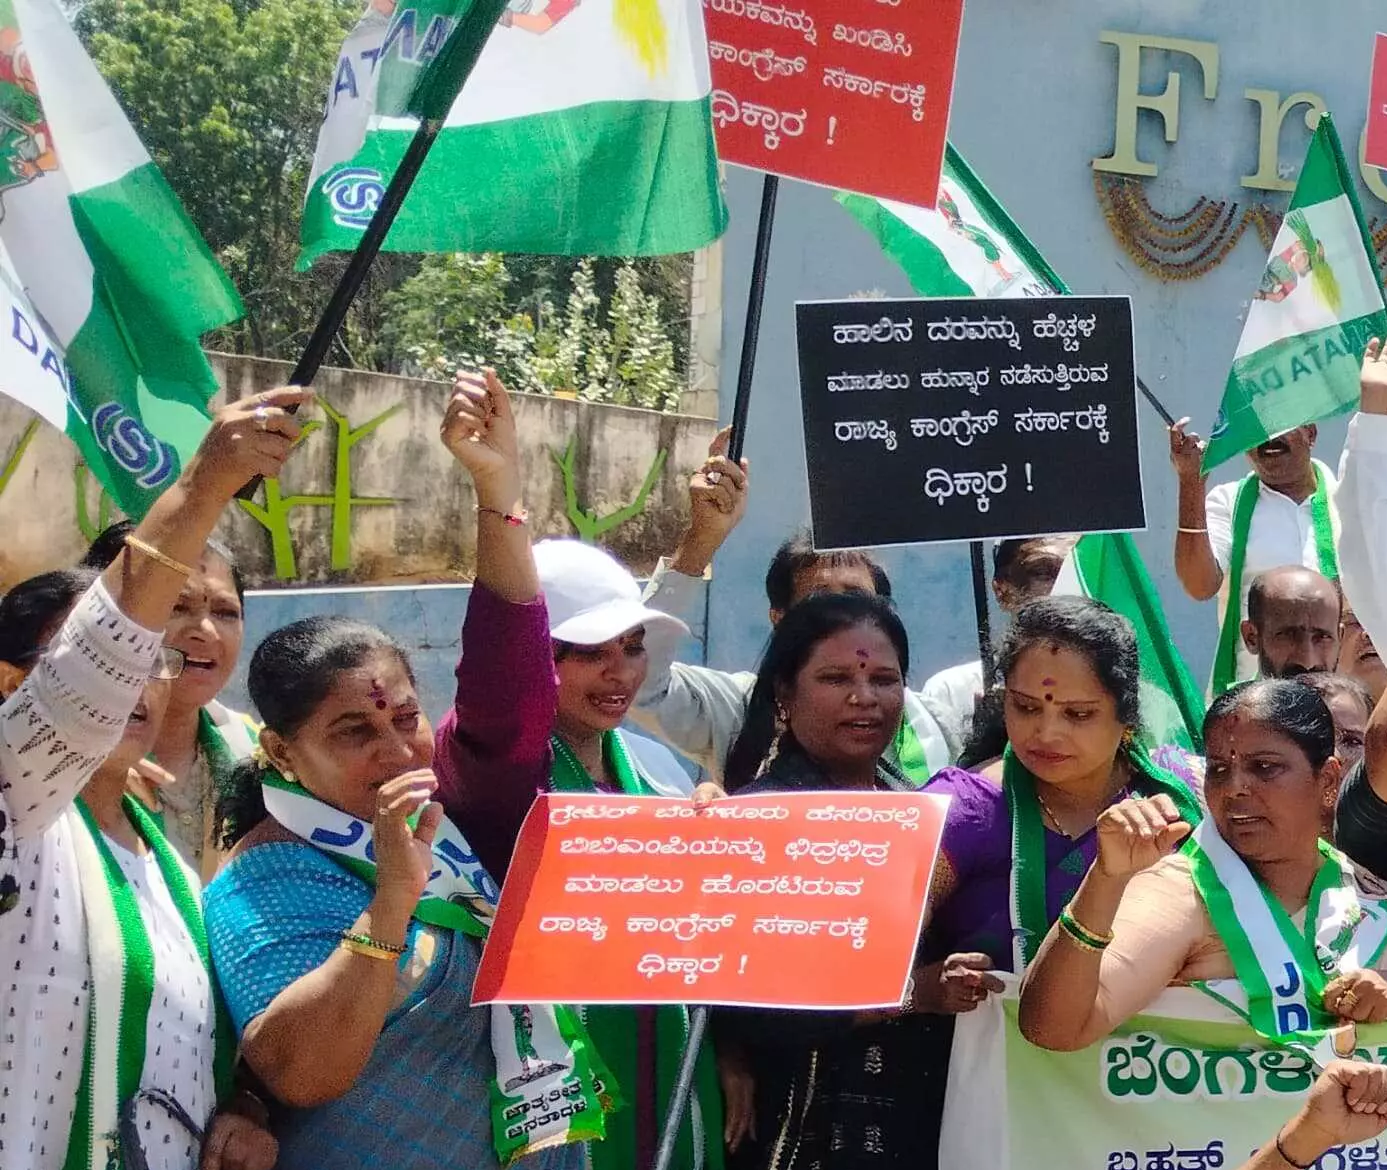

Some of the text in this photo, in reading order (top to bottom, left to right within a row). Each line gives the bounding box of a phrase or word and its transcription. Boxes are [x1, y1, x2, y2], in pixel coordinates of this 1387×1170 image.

[709, 40, 926, 122] ಕಾಂಗ್ರೆಸ್ ಸರ್ಕಾರಕ್ಕೆ
[710, 89, 837, 150] ಧಿಕ್ಕಾರ !
[833, 313, 1097, 352] ಹಾಲಿನ ದರವನ್ನು ಹೆಚ್ಚಳ
[828, 363, 1108, 395] ಮಾಡಲು ಹುನ್ನಾರ ನಡೆಸುತ್ತಿರುವ
[835, 404, 1109, 450] ರಾಜ್ಯ ಕಾಂಗ್ರೆಸ್ ಸರ್ಕಾರಕ್ಕೆ
[924, 463, 1033, 512] ಧಿಕ್ಕಾರ !
[549, 804, 921, 830] ಗ್ರೇಟರ್ ಹೆಸರಿನಲ್ಲಿ
[565, 874, 864, 896] ಮಾಡಲು ಹೊರಟಿರುವ
[539, 913, 869, 949] ರಾಜ್ಯ ಕಾಂಗ್ರೆಸ್ ಸರ್ಕಾರಕ್ಕೆ
[637, 953, 722, 985] ಧಿಕ್ಕಾರ
